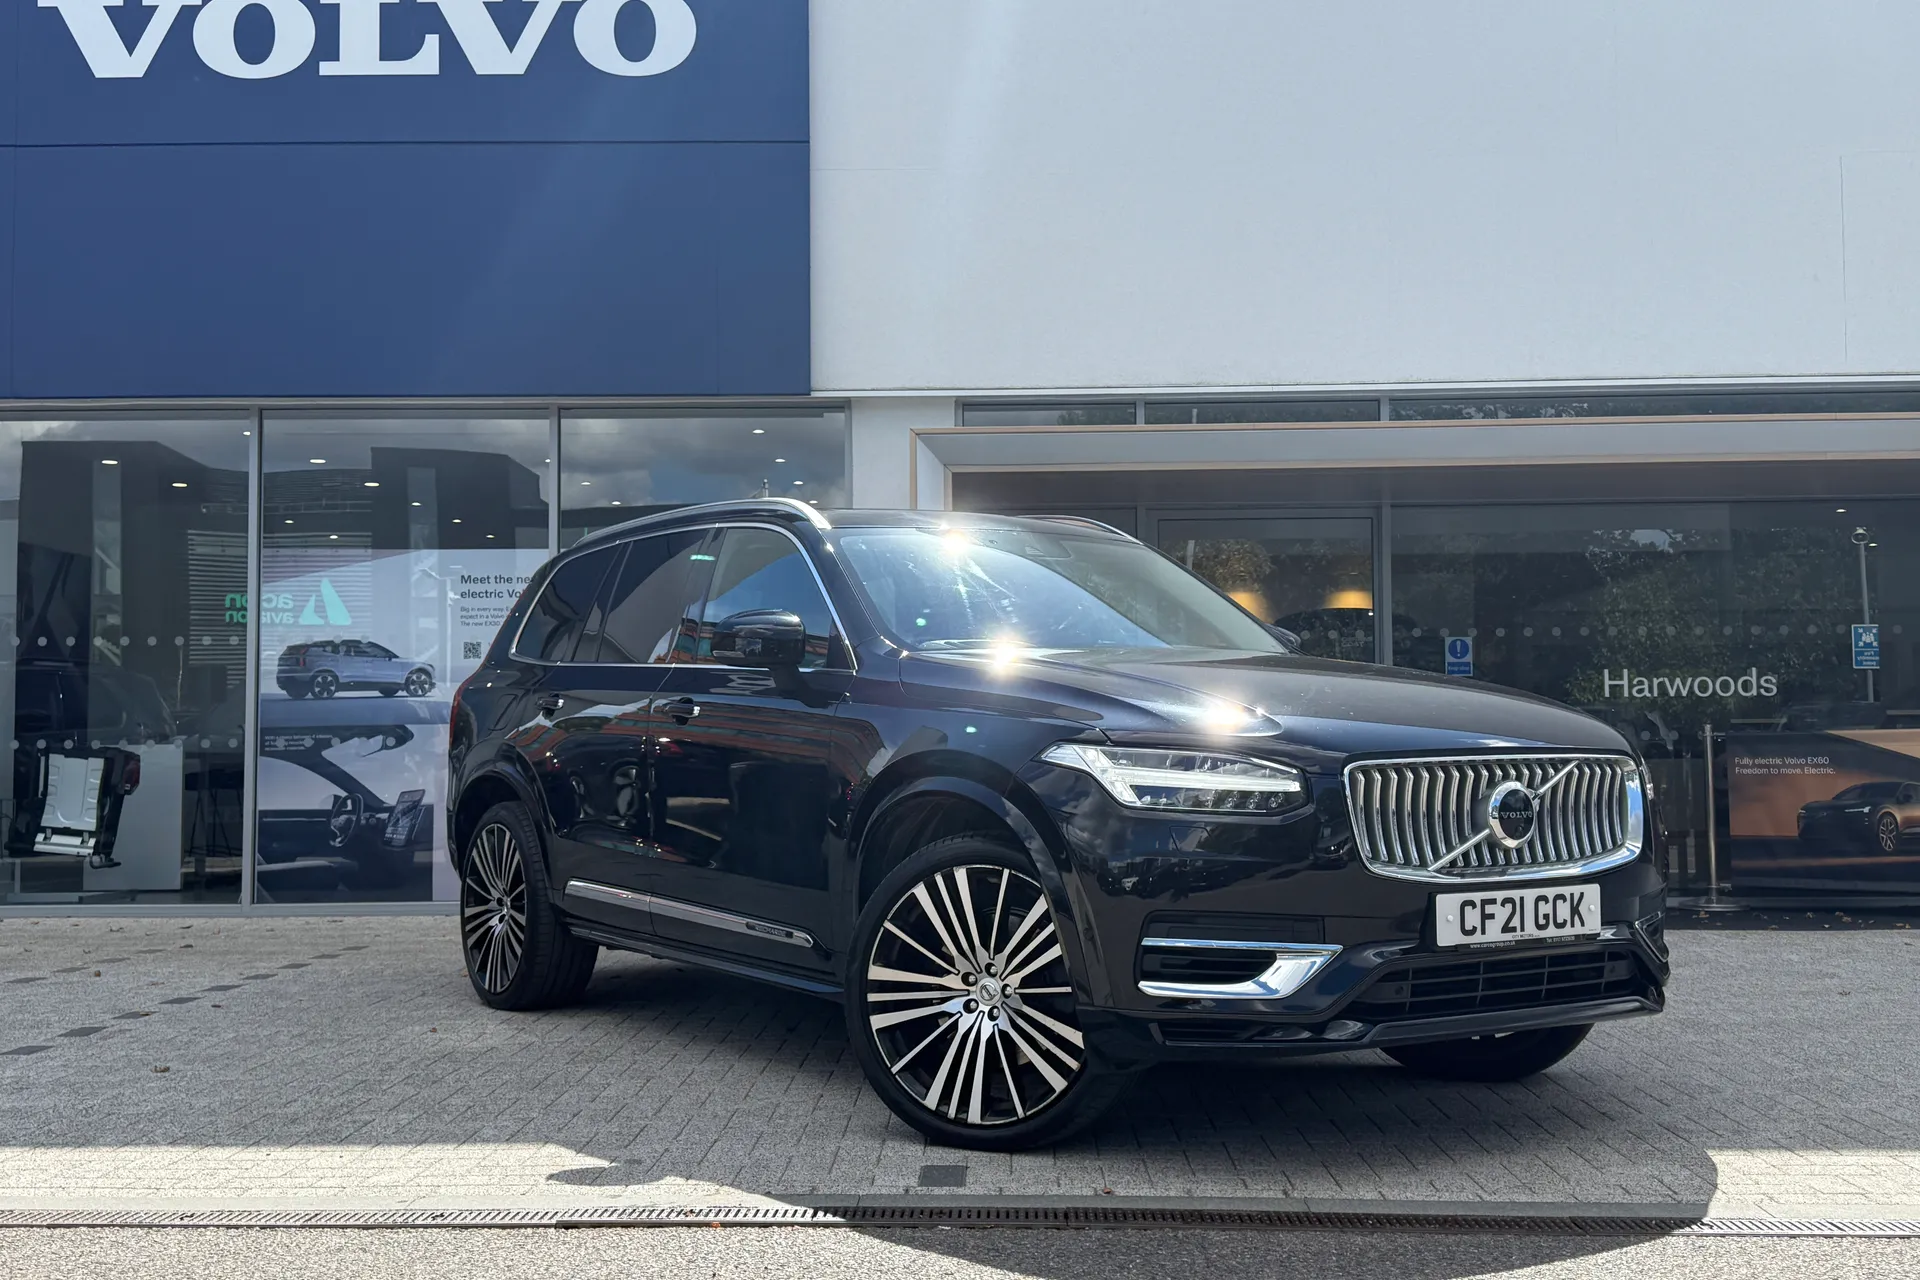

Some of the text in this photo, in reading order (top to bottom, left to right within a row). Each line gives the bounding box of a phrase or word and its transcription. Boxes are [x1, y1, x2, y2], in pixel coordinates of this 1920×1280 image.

[37, 0, 698, 79] VOLVO
[460, 575, 491, 584] Meet
[494, 575, 513, 584] the
[460, 589, 504, 598] electric
[1603, 667, 1778, 697] Harwoods
[1735, 756, 1830, 766] Fully electric Volvo EX60
[1735, 767, 1769, 775] Freedom
[1804, 767, 1836, 775] Electric.
[1500, 811, 1533, 819] VOLVO
[1459, 891, 1586, 936] CF21 GCK
